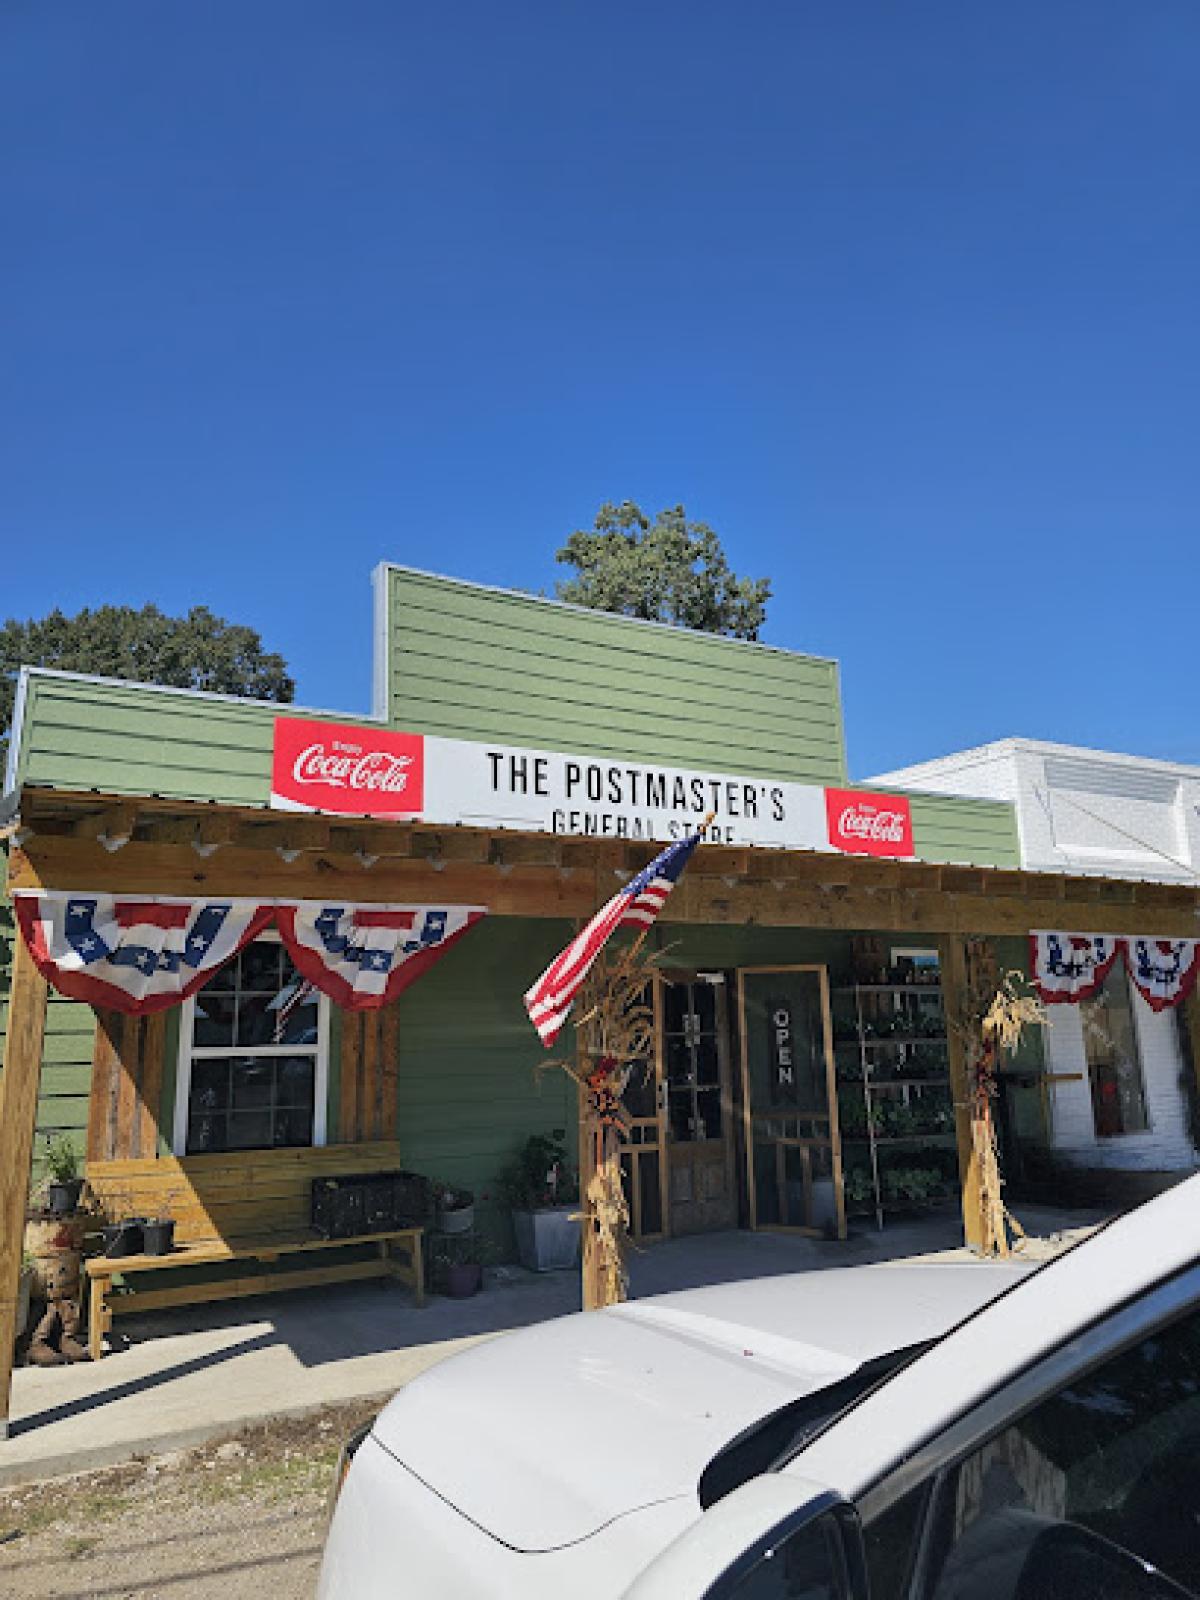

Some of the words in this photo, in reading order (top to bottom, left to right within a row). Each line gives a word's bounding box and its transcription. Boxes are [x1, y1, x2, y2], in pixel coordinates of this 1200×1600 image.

[487, 752, 549, 795] THE
[565, 761, 785, 821] POSTMASTER'S
[552, 808, 654, 837] GENERAL
[773, 1008, 792, 1084] OPEN
